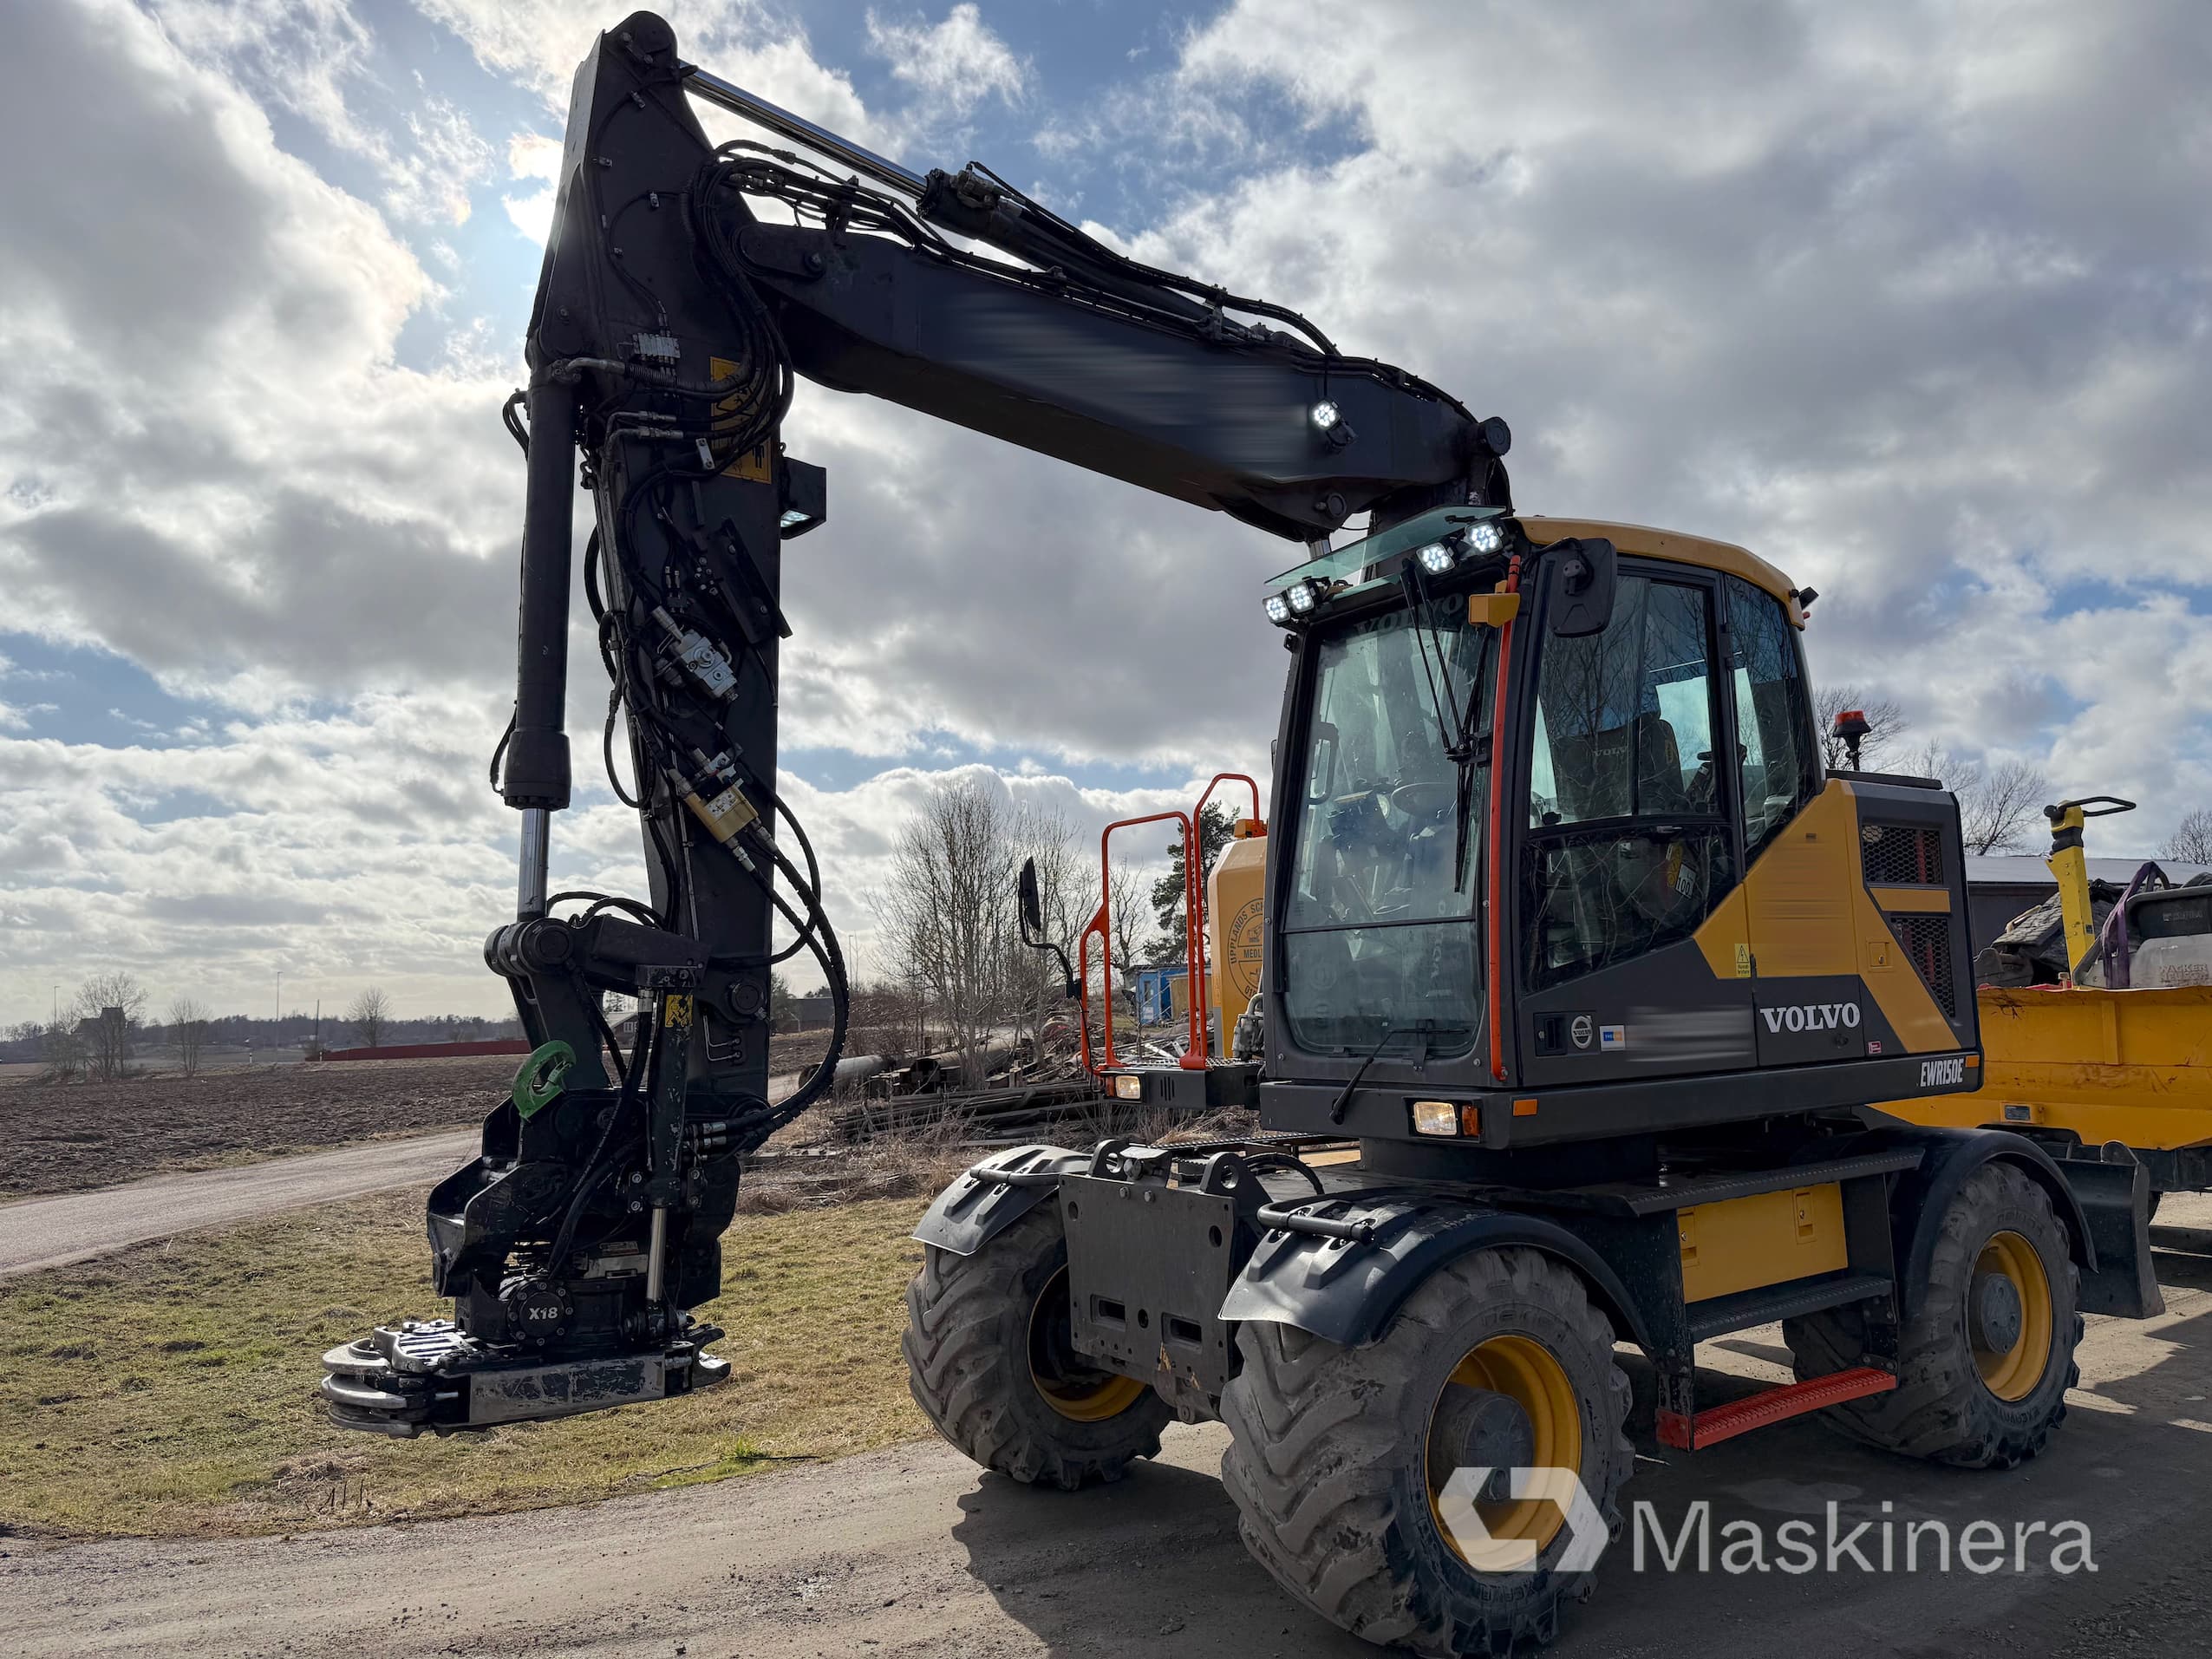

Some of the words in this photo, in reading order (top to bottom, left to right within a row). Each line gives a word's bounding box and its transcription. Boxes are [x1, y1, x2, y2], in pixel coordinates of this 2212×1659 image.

[1677, 876, 1691, 895] 100
[1230, 911, 1249, 964] UPPLANDS
[1759, 1003, 1861, 1034] VOLVO
[1920, 1058, 1964, 1087] EWR150E
[529, 1307, 558, 1320] X18
